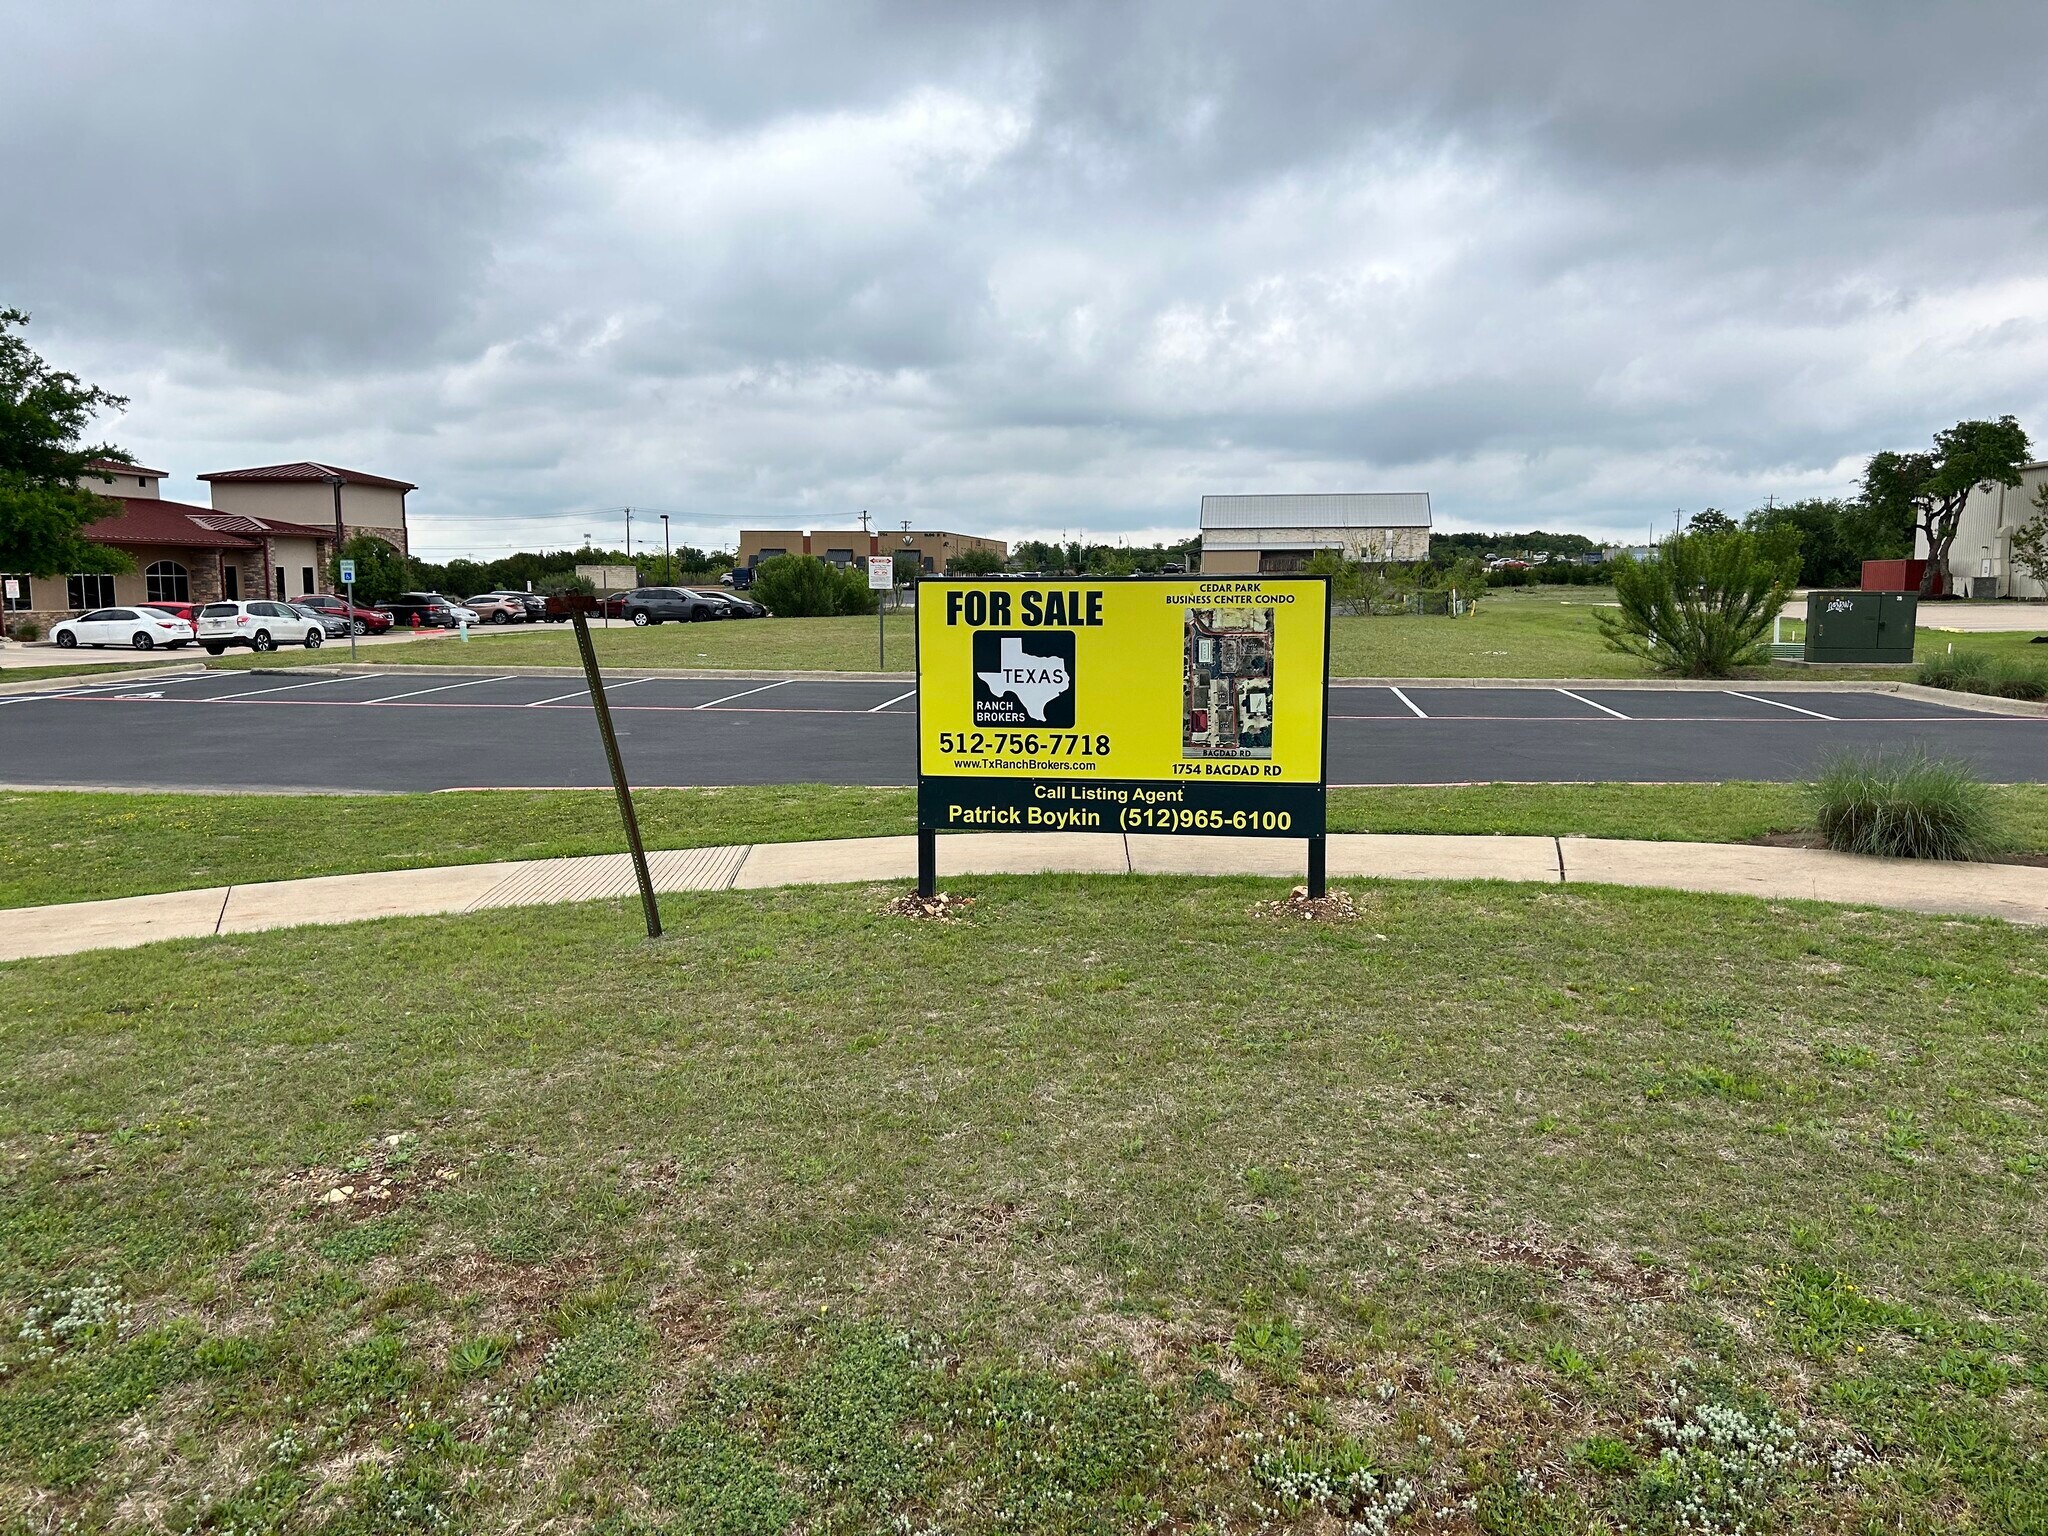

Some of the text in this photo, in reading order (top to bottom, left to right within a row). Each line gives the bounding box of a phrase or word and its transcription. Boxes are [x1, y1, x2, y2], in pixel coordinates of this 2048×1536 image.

[1199, 583, 1261, 593] CEDAR PARK
[1166, 594, 1295, 604] BUSINESS CENTER CONDO
[946, 590, 1104, 627] FOR SALE
[1002, 668, 1064, 684] TEXAS
[976, 700, 1014, 711] RANCH
[976, 712, 1026, 722] BROKERS
[939, 733, 1111, 756] 512-756-7718
[1203, 749, 1252, 757] BAGDAD RD
[954, 758, 1096, 771] www.TxRanchBrokers.com
[1172, 763, 1282, 776] 1754 BAGDAD RD
[1034, 785, 1184, 804] Call Listing Agent
[948, 804, 1292, 833] Patrick Boykin (512)965-6100
